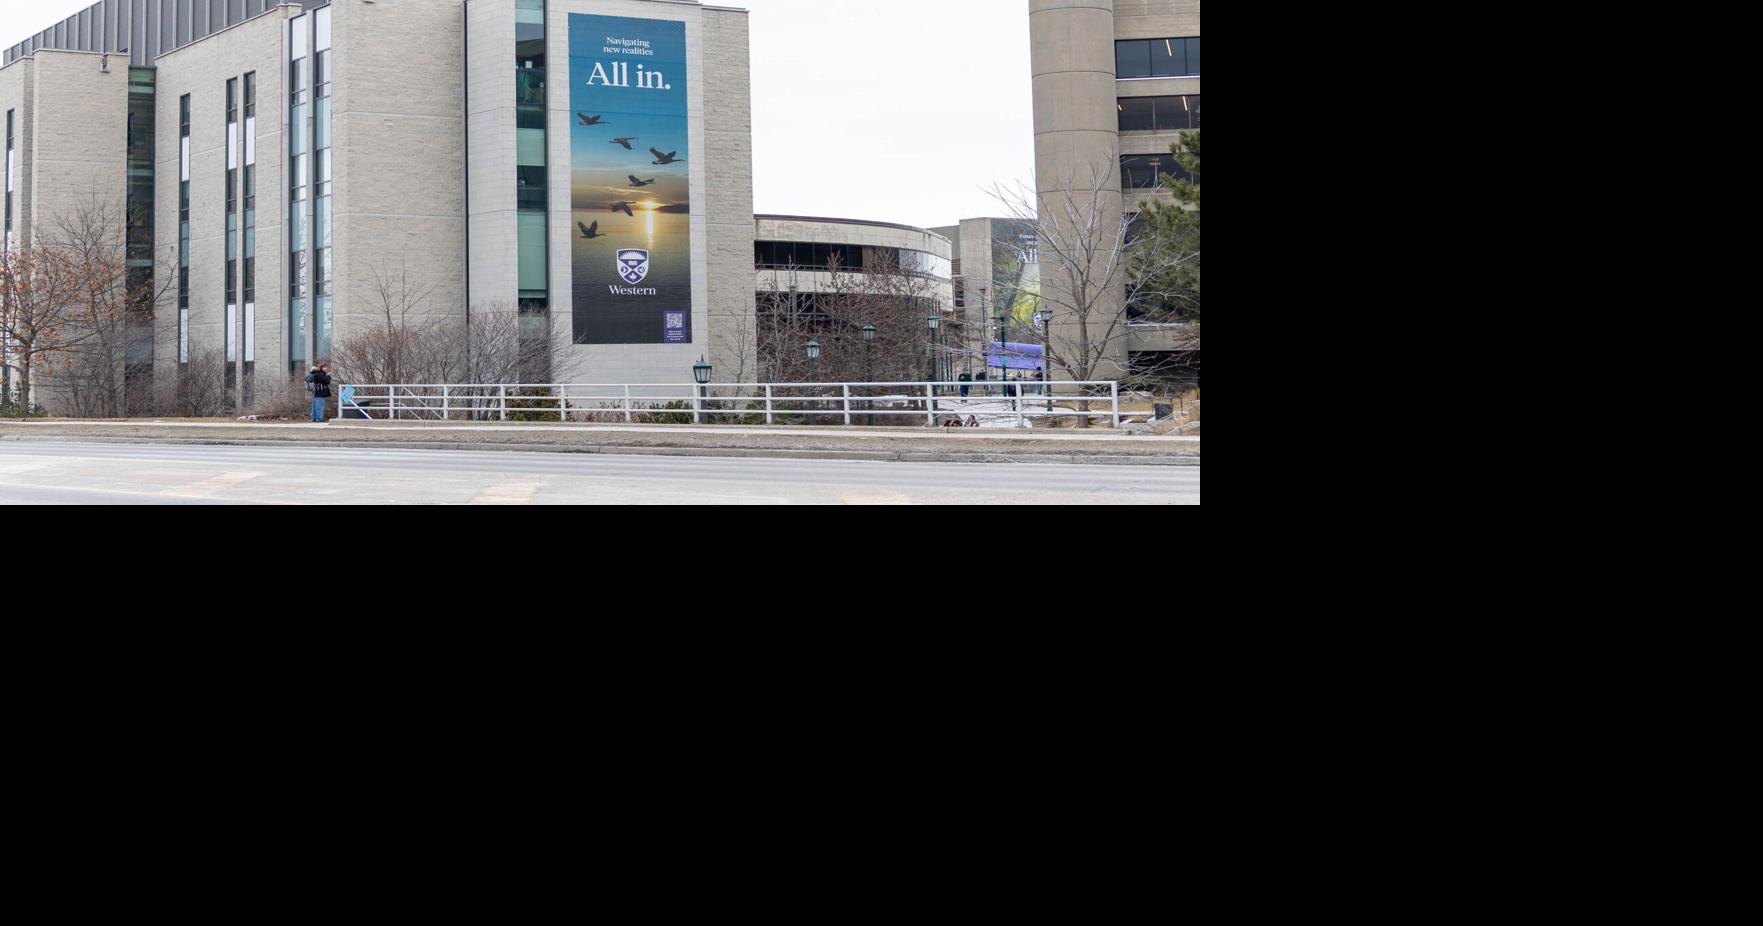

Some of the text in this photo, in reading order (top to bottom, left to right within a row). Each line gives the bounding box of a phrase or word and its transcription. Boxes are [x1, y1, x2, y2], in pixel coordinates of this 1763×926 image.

[606, 36, 650, 48] Navigating
[622, 46, 653, 56] realities
[586, 61, 671, 90] All in.
[608, 285, 656, 295] Western
